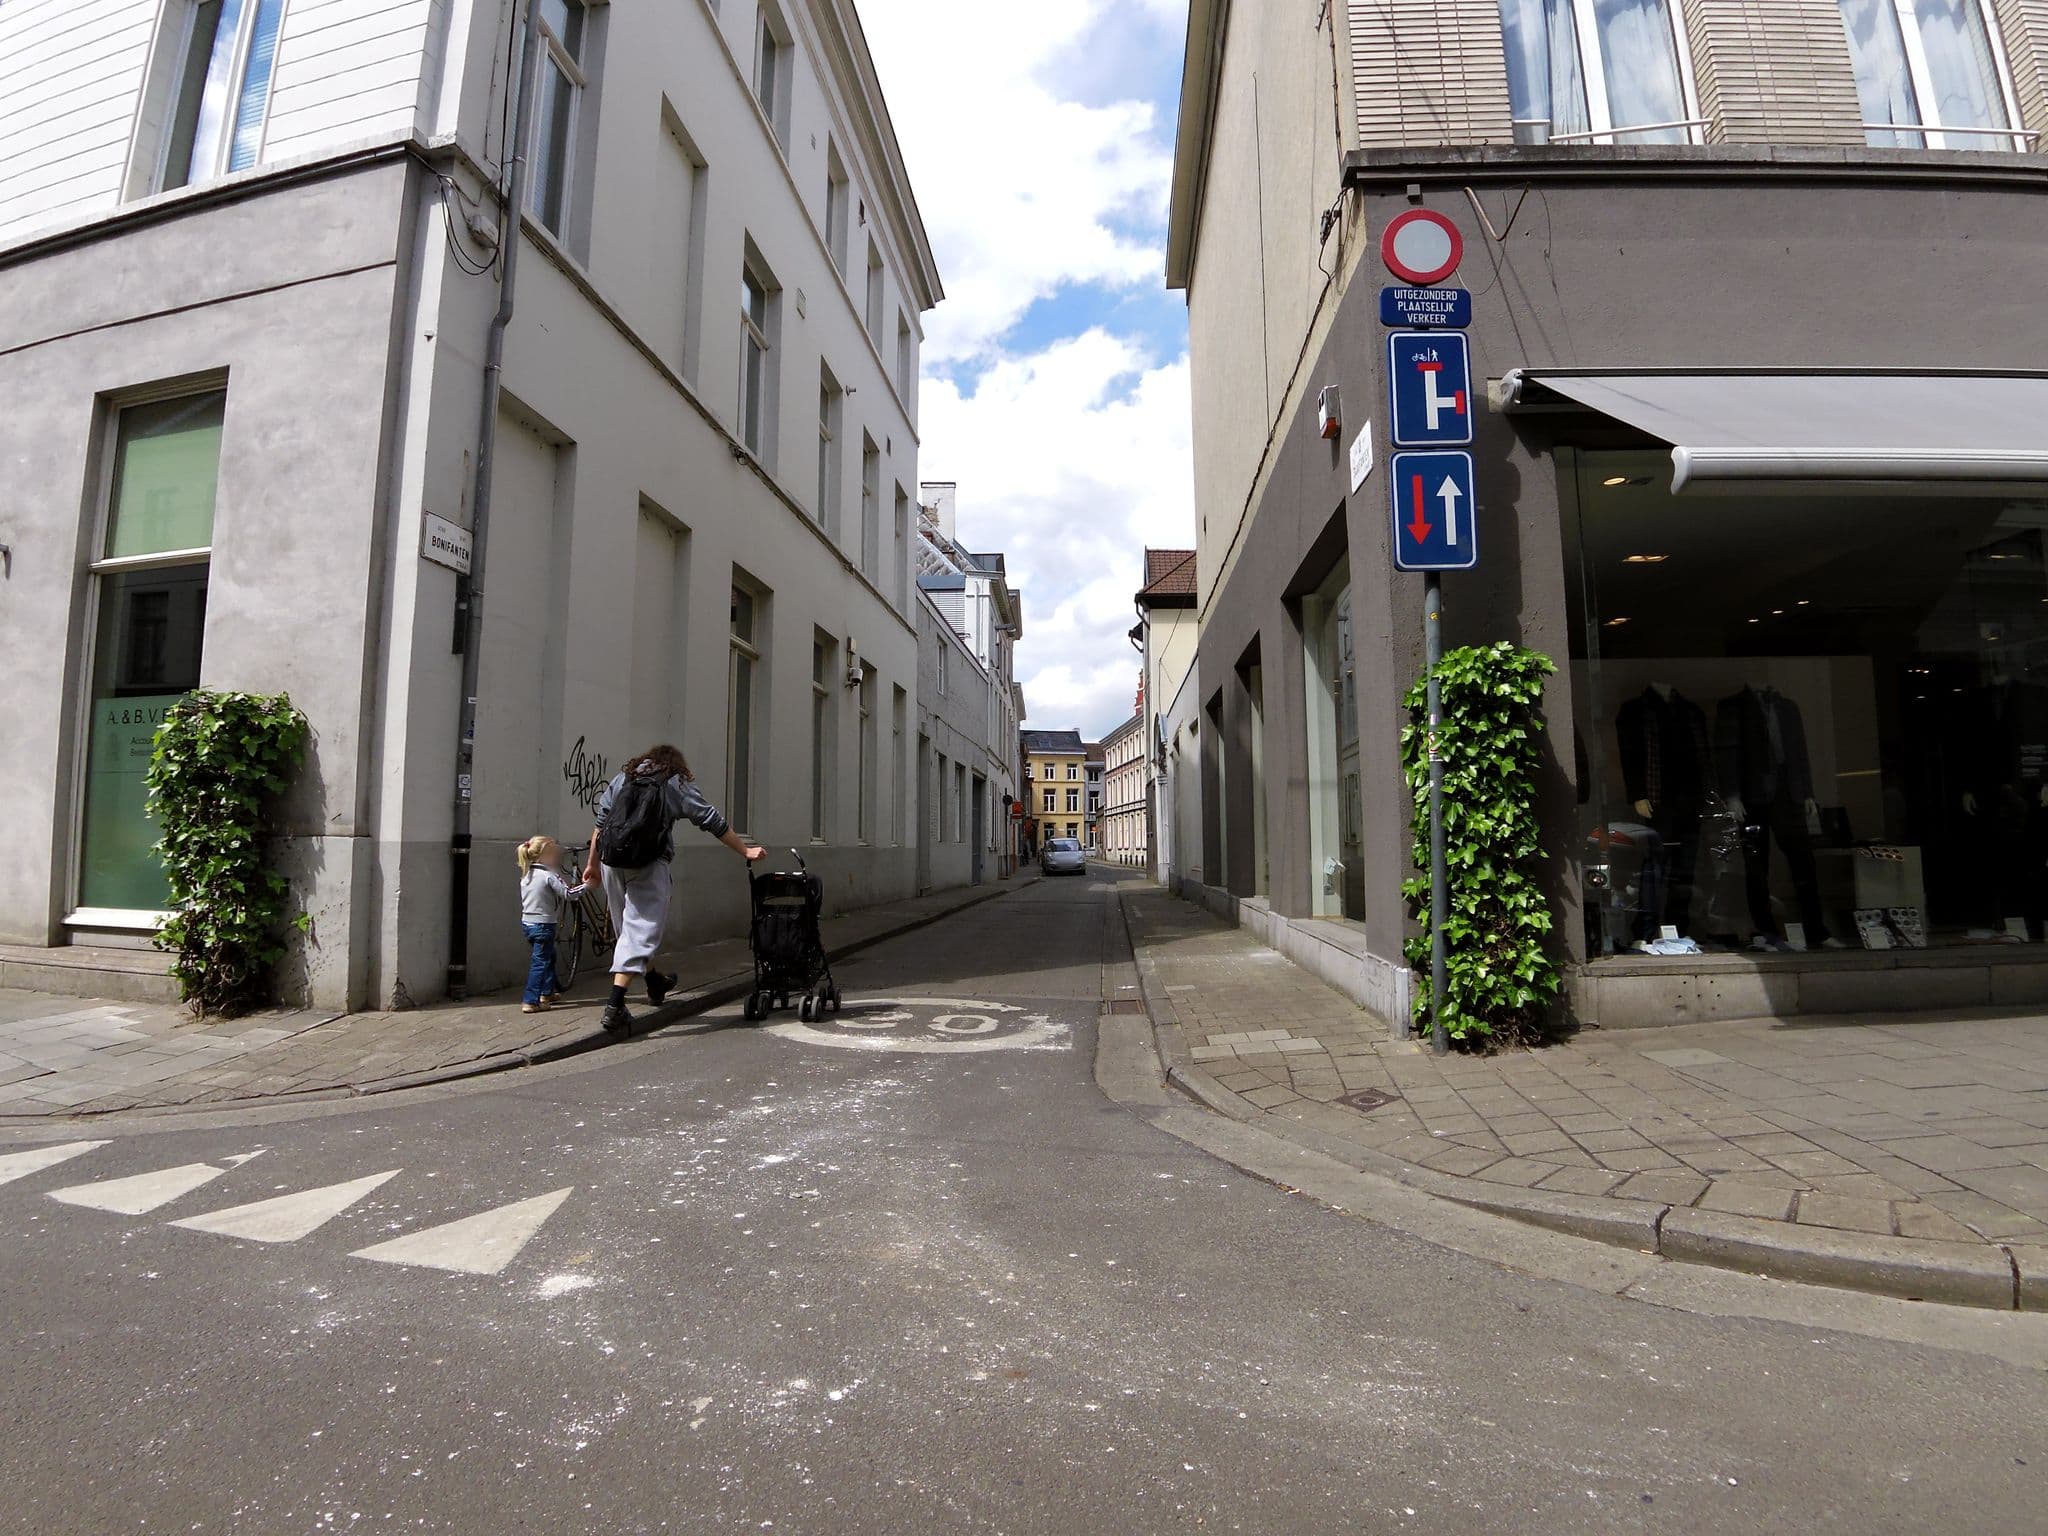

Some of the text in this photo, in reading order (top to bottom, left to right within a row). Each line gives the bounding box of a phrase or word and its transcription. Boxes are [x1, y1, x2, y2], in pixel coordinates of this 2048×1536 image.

[1394, 289, 1458, 301] UITGEZONDERD
[1397, 301, 1455, 313] PLAATSELIJK
[1407, 313, 1447, 324] VERKEER
[431, 535, 470, 561] BONIFANTEN
[121, 709, 130, 725] &
